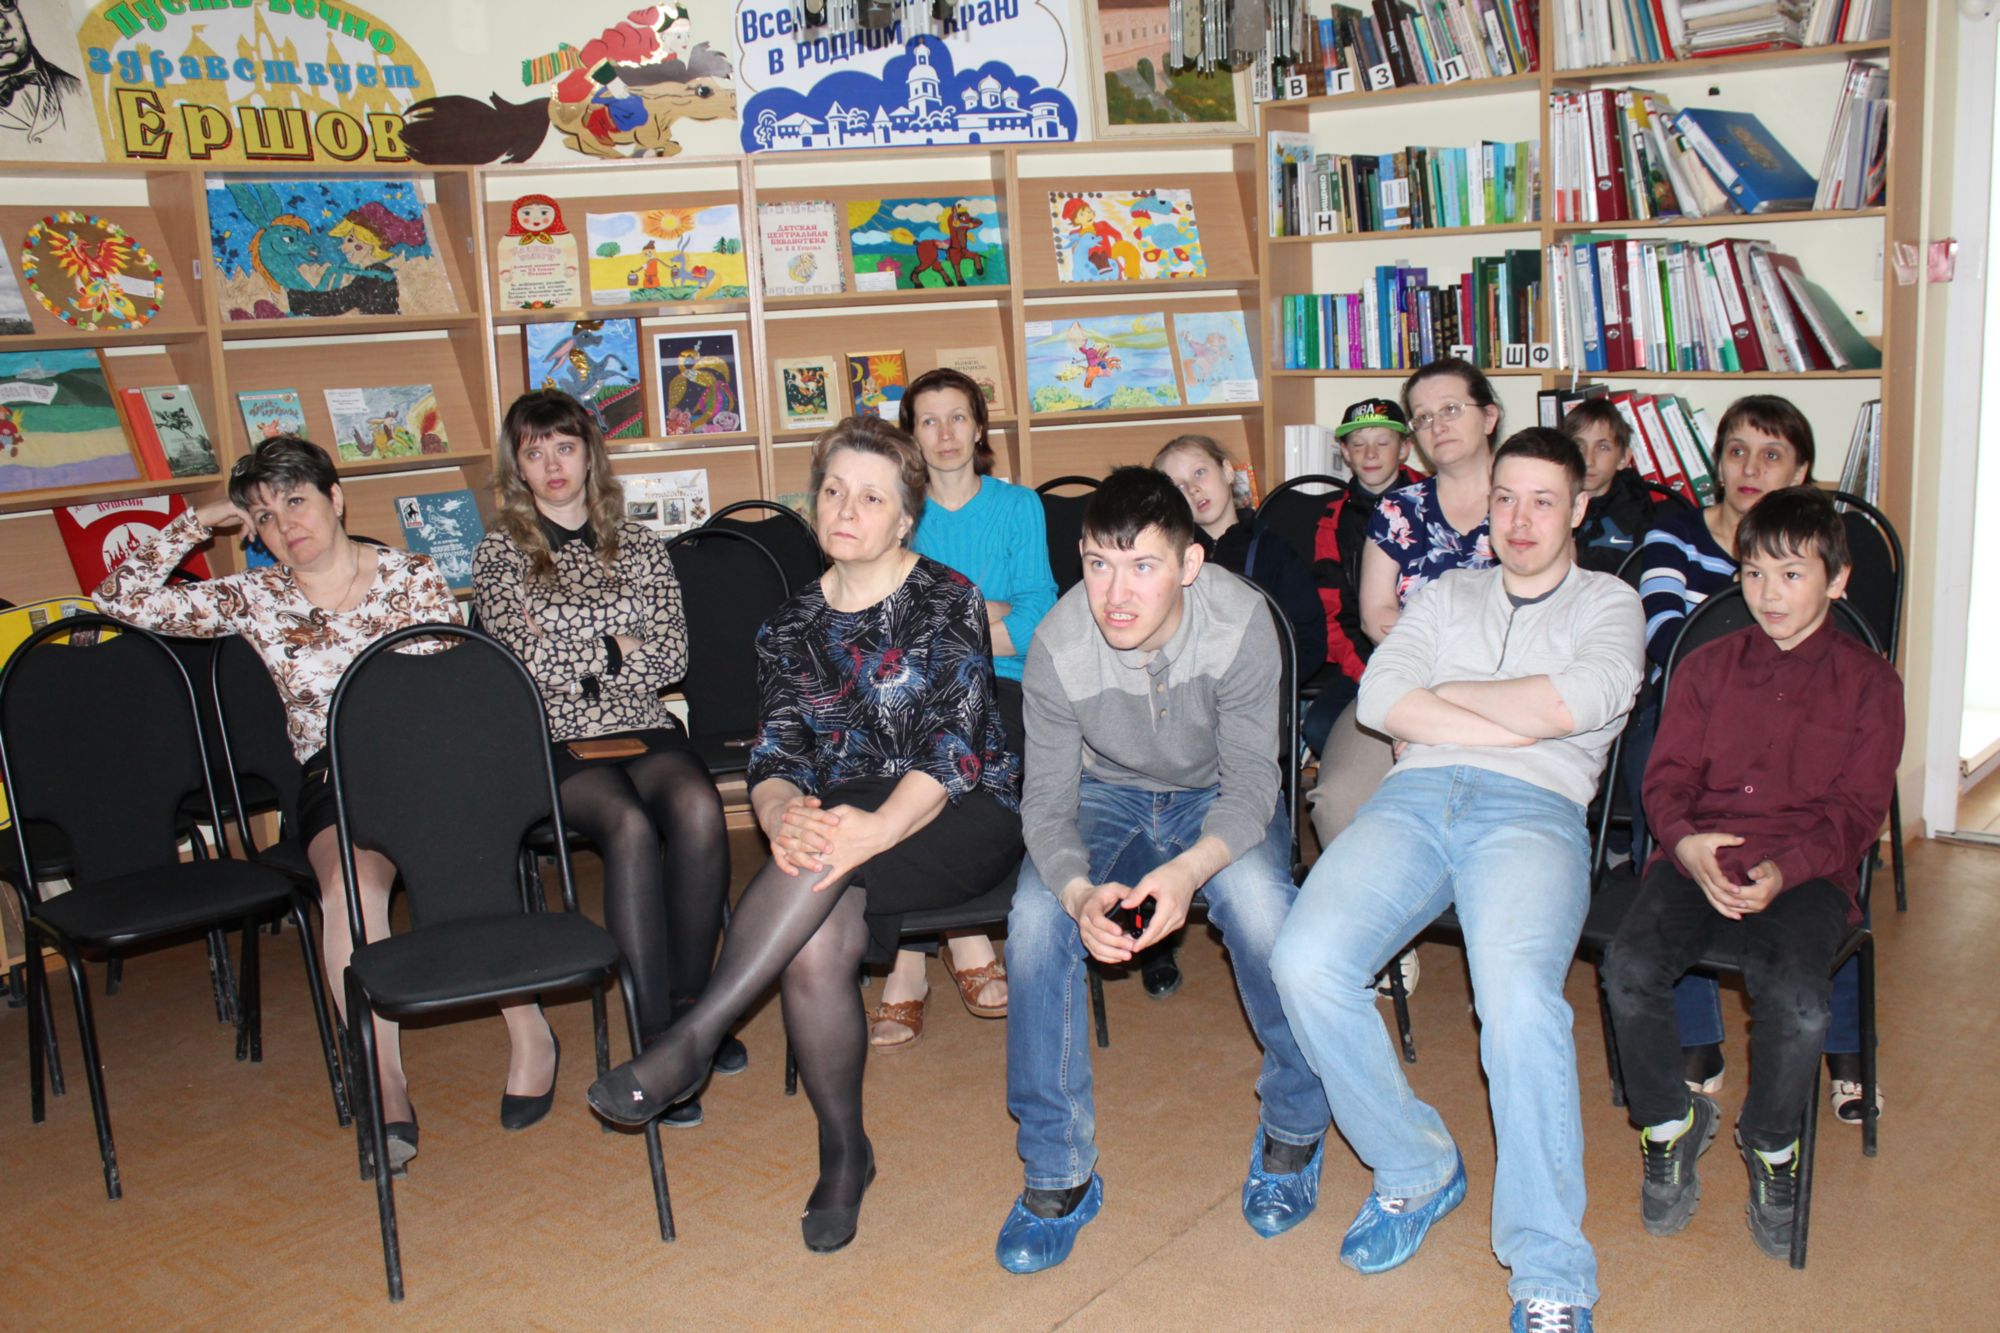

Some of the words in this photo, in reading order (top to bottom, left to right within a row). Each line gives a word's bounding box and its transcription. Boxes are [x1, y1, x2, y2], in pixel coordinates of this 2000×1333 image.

[88, 47, 420, 93] здравствует
[1445, 61, 1460, 80] Л
[1291, 79, 1304, 96] В
[1338, 72, 1350, 90] Г
[1319, 215, 1332, 231] Н
[1507, 347, 1523, 365] Ш
[1533, 346, 1549, 363] Ф
